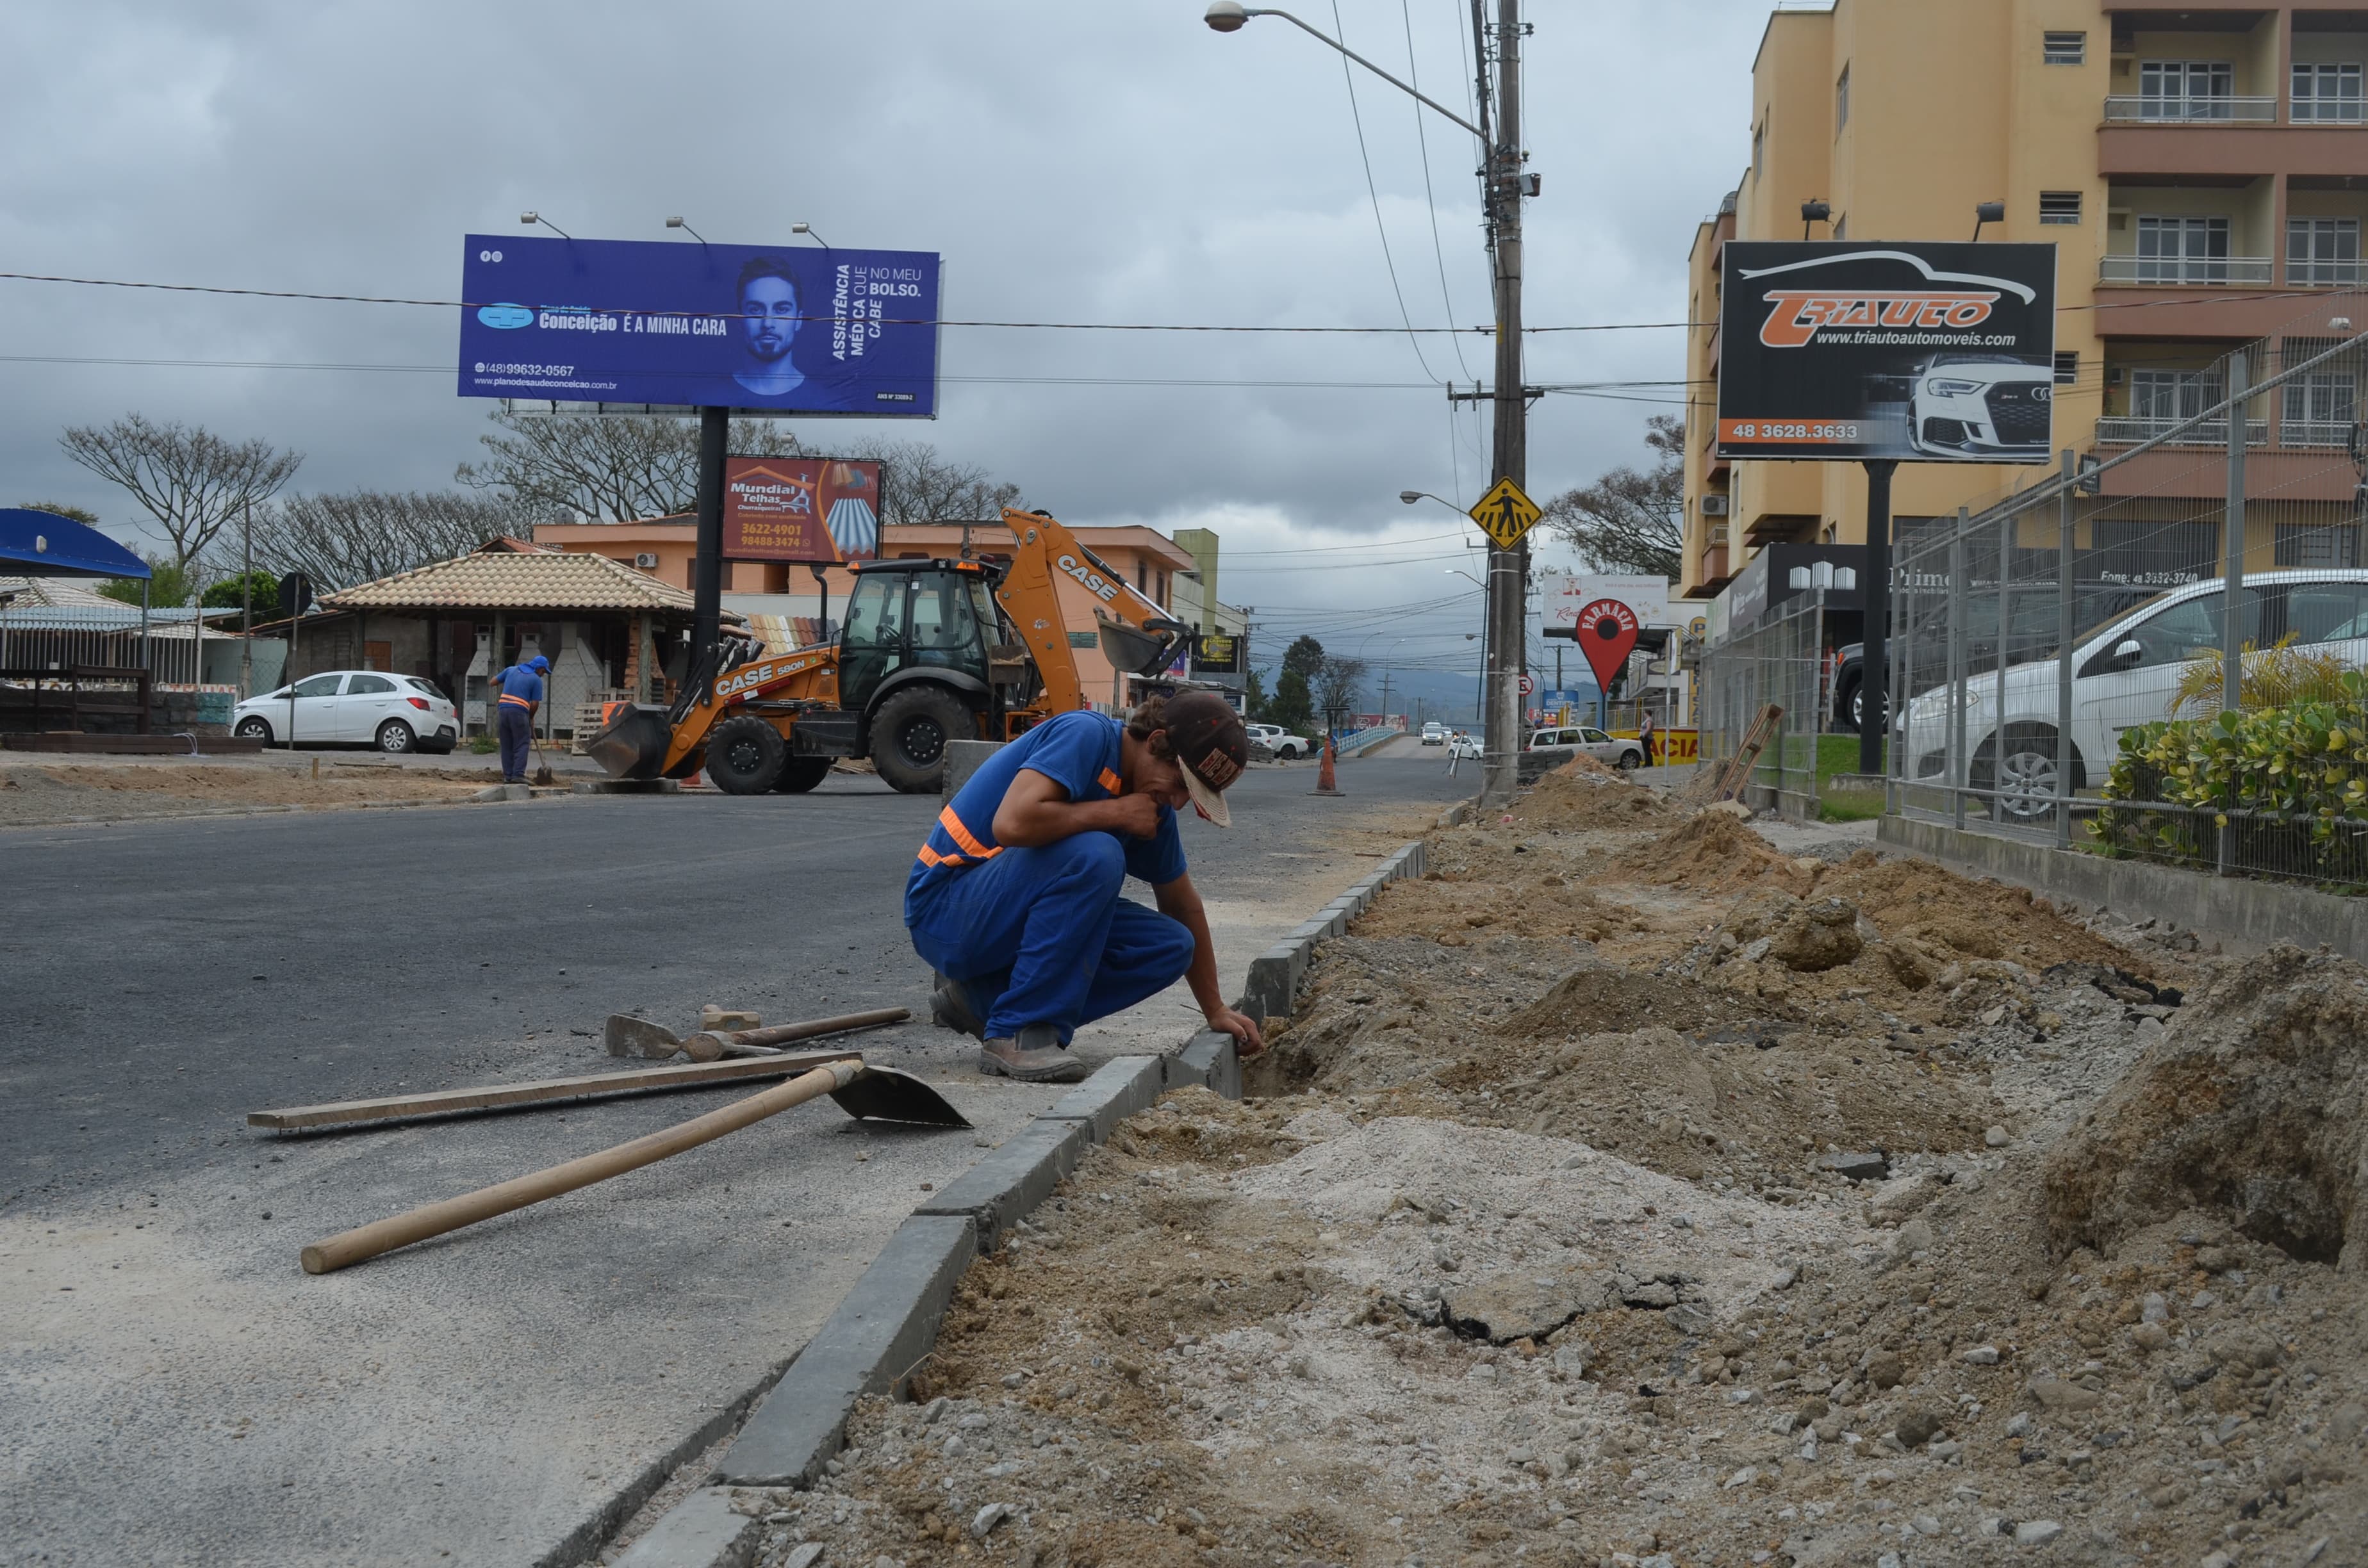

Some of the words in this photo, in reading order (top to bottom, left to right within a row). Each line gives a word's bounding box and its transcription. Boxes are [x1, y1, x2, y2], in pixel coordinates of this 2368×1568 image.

[853, 266, 867, 295] QUE
[870, 267, 889, 279] NO
[893, 268, 921, 281] MEU
[869, 283, 921, 297] BOLSO.
[833, 265, 850, 361] ASSISTÊNCIA
[868, 299, 882, 338] CABE
[539, 313, 617, 333] Conceição
[623, 313, 632, 332] É
[634, 316, 643, 332] A
[647, 316, 689, 334] MINHA
[693, 318, 727, 336] CARA
[849, 299, 866, 355] MÉDICA
[1817, 331, 2016, 347] www.triautoautomoveis.com
[474, 377, 617, 389] www.planodesaudeconceicao.com.br
[1732, 424, 1755, 437] 48
[1762, 424, 1857, 438] 3628.3633
[731, 483, 795, 494] Mundial
[742, 493, 781, 503] Telhas
[742, 523, 802, 535] 3622-4901
[1057, 555, 1119, 601] CASE
[1582, 603, 1633, 631] FARMÁCIA
[777, 660, 805, 676] 580N
[716, 664, 773, 696] CASE
